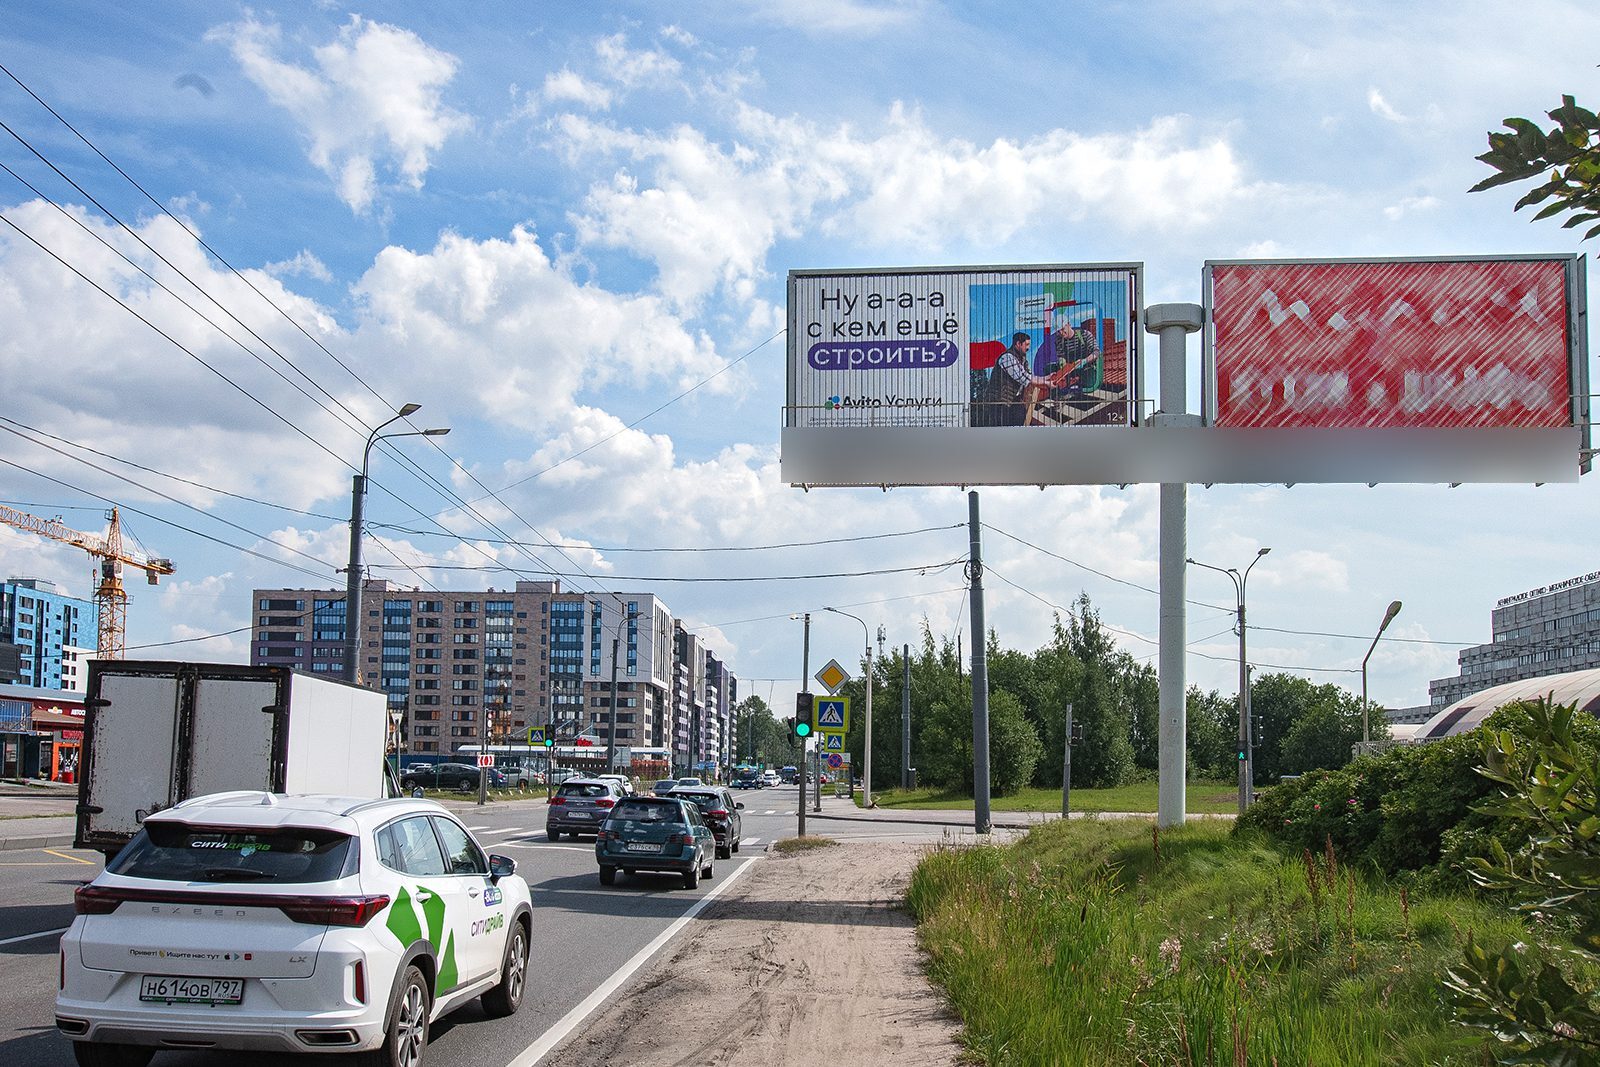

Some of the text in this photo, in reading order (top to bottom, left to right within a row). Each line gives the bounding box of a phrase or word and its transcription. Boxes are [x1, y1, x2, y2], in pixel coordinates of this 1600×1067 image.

[821, 289, 945, 315] Ну а-а-а
[807, 313, 959, 338] с кем ещё
[814, 341, 950, 369] строить?
[843, 395, 942, 411] Avito Услуги
[152, 906, 246, 917] EXEED
[129, 949, 157, 957] Привет!
[166, 952, 191, 960] Ищите
[213, 981, 239, 994] 797
